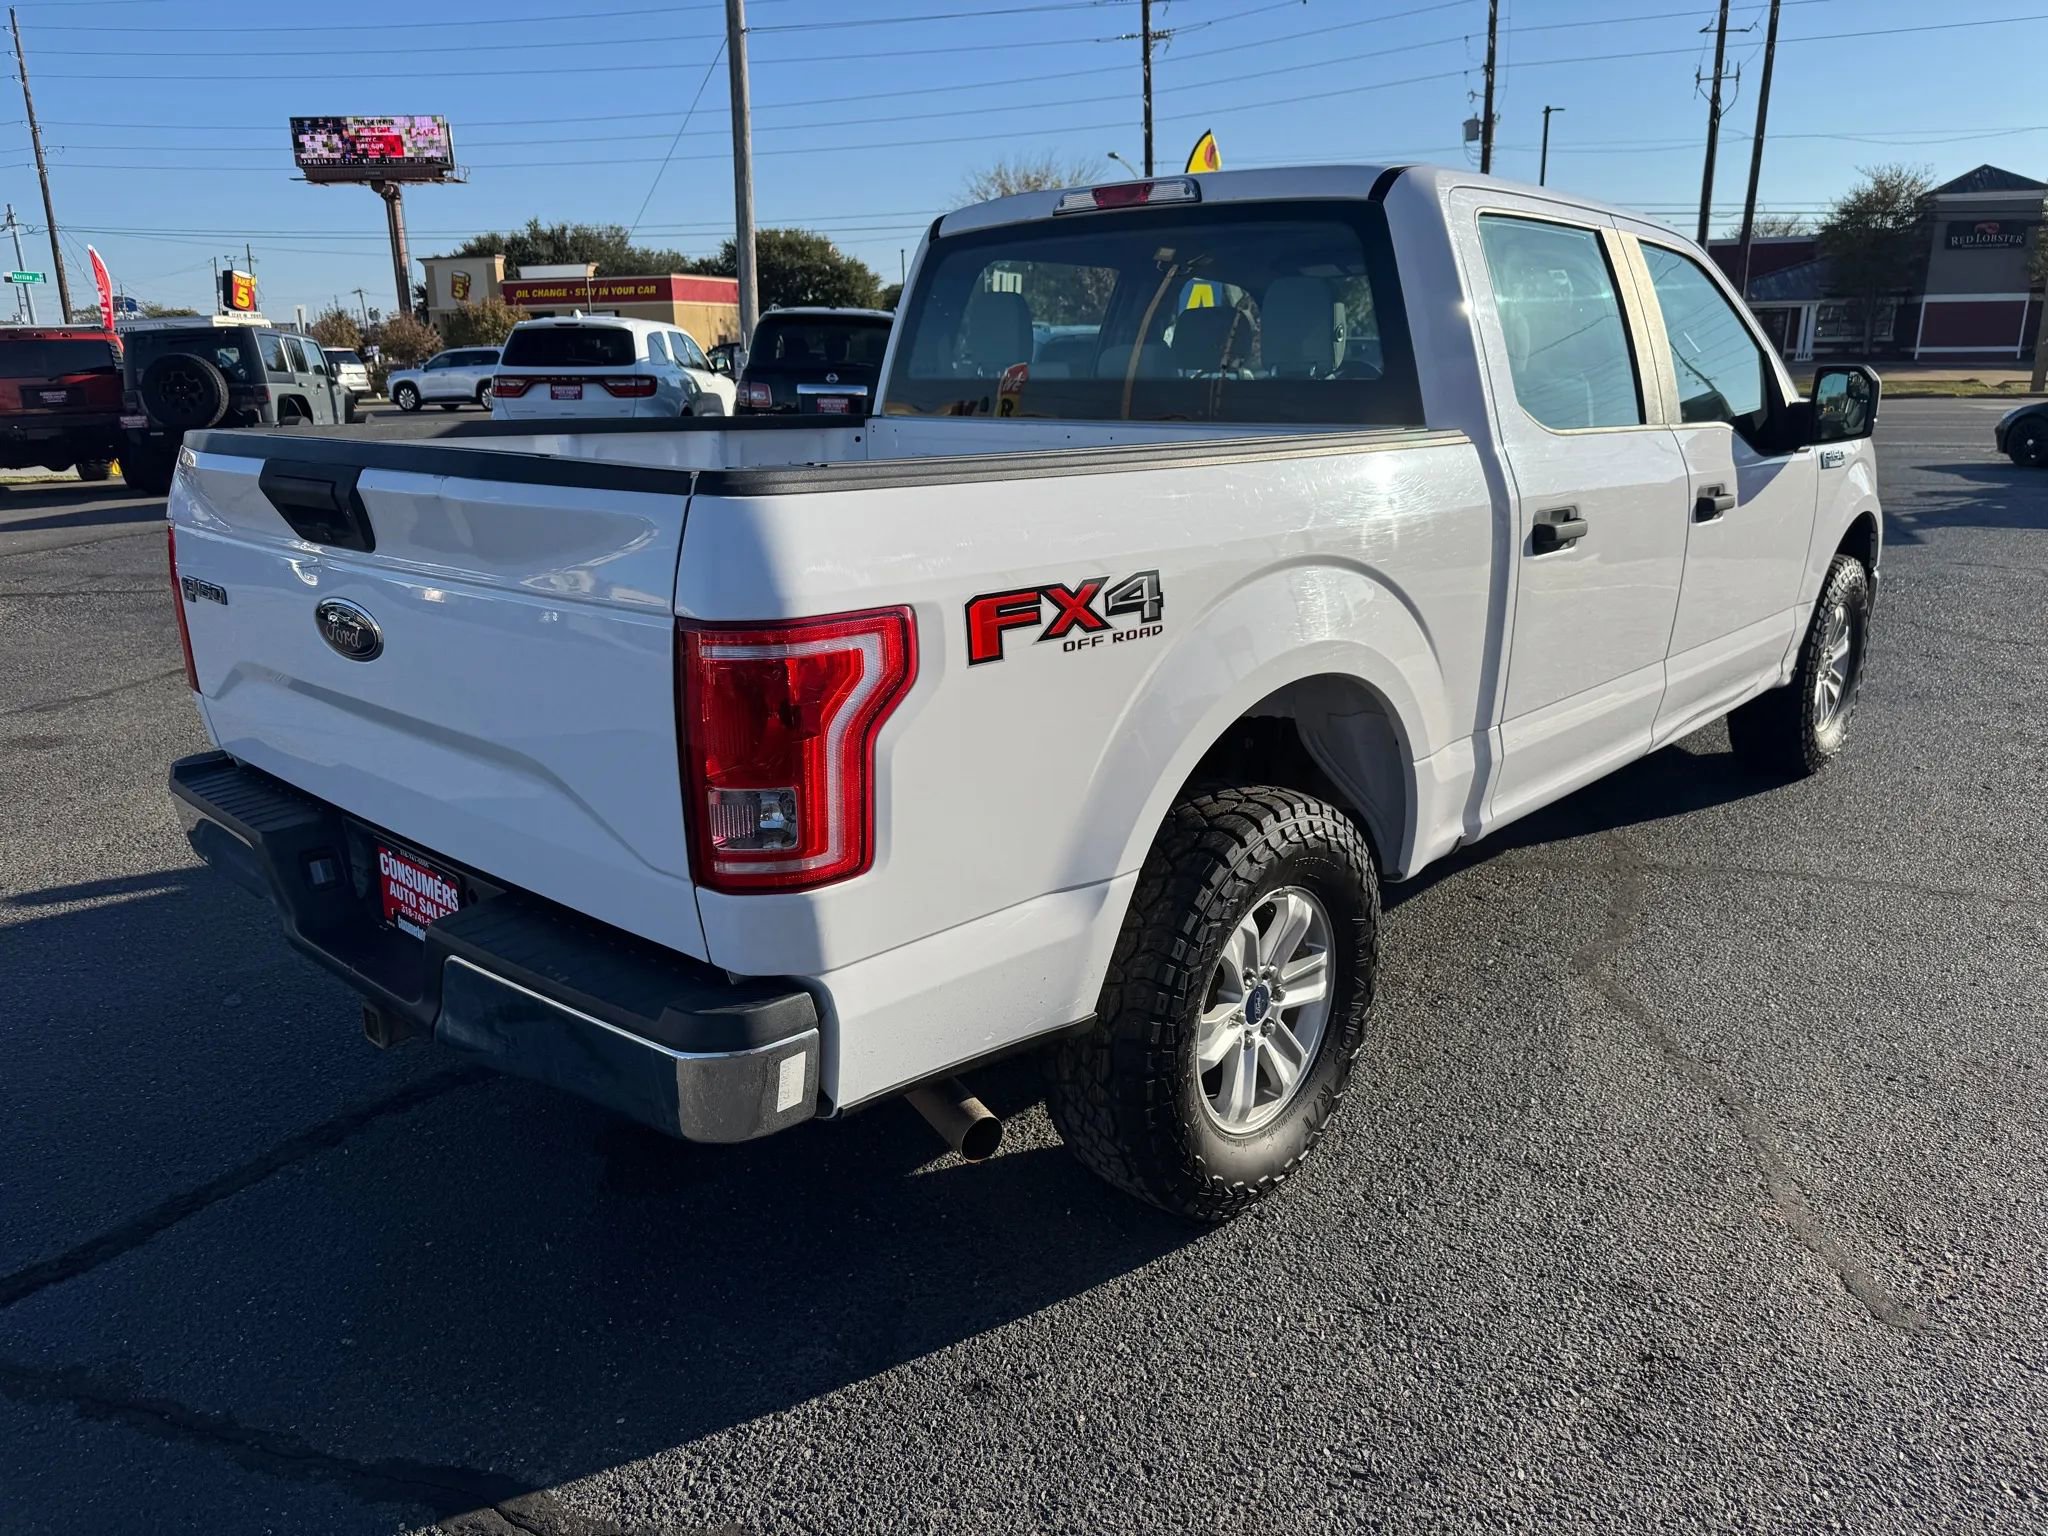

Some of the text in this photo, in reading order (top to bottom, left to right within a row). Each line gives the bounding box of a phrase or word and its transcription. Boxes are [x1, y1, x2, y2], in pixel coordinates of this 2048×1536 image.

[1951, 234, 1974, 246] RED
[1976, 232, 2023, 244] LOBSTER
[234, 276, 251, 287] TAKE
[515, 289, 530, 298] OIL
[531, 288, 568, 297] CHANGE
[600, 287, 609, 296] IN
[611, 286, 636, 296] YOUR
[637, 285, 657, 294] CAR
[236, 287, 250, 308] 5
[964, 569, 1164, 667] FX4
[326, 620, 361, 648] Ford
[1063, 624, 1164, 652] OFF ROAD
[379, 852, 459, 912] CONSUMERS
[389, 881, 417, 908] AUTO
